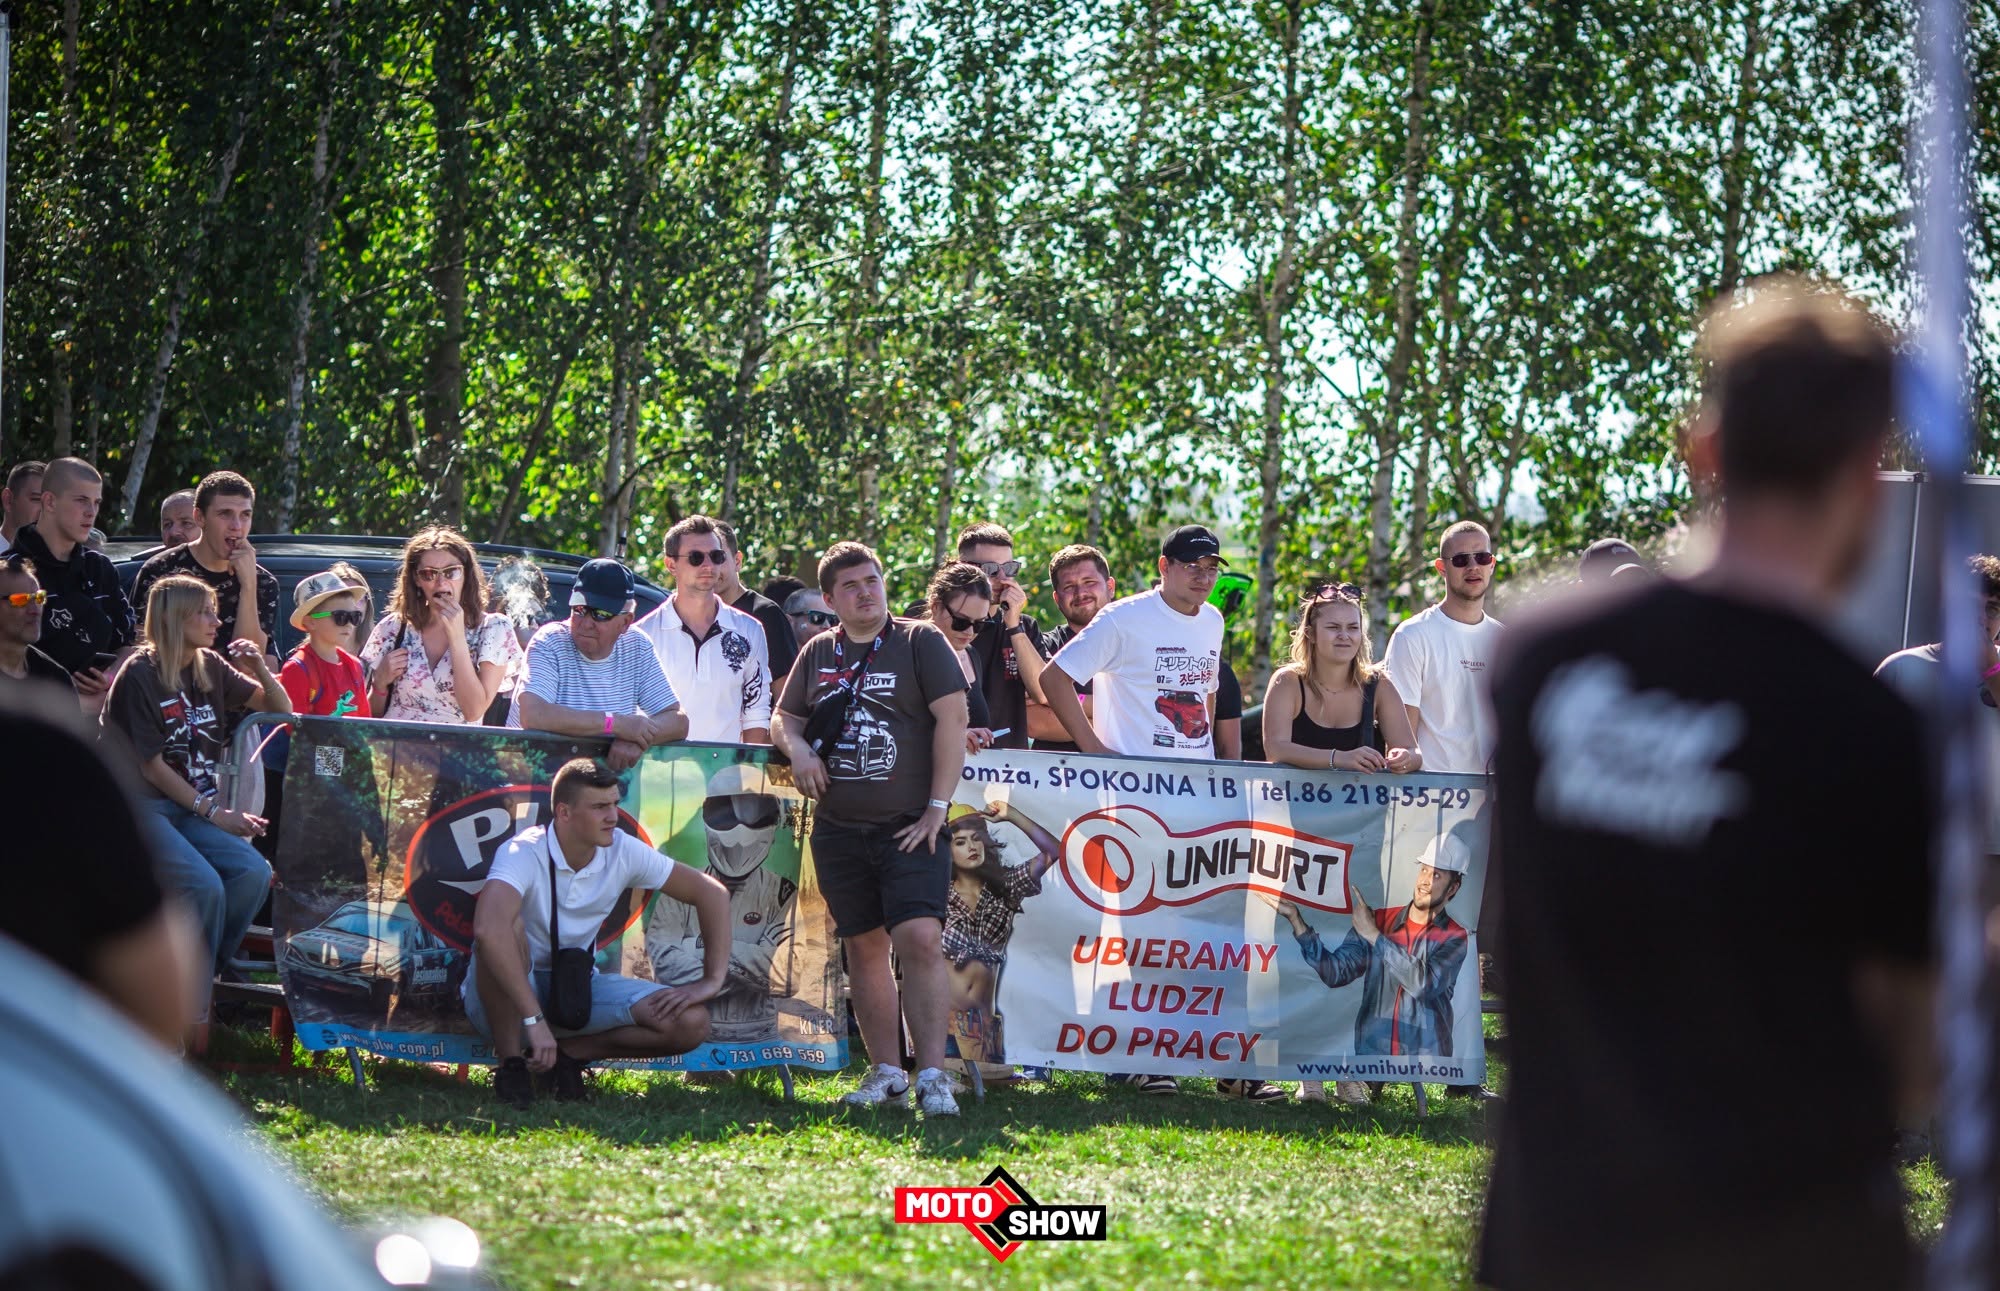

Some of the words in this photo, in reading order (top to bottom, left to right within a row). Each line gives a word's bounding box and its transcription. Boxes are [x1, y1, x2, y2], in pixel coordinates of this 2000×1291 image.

[961, 763, 1040, 789] omża,
[1050, 766, 1196, 797] SPOKOJNA
[1207, 777, 1238, 799] 1B
[1341, 782, 1471, 810] 218-55-29
[1166, 837, 1339, 896] UNIHURT
[1072, 935, 1279, 973] UBIERAMY
[1108, 981, 1225, 1016] LUDZI
[729, 1049, 756, 1064] 731
[762, 1046, 793, 1060] 669
[799, 1048, 826, 1064] 559
[1055, 1023, 1118, 1055] DO
[1126, 1026, 1262, 1063] PRACY
[1296, 1060, 1464, 1078] www.unihurt.com
